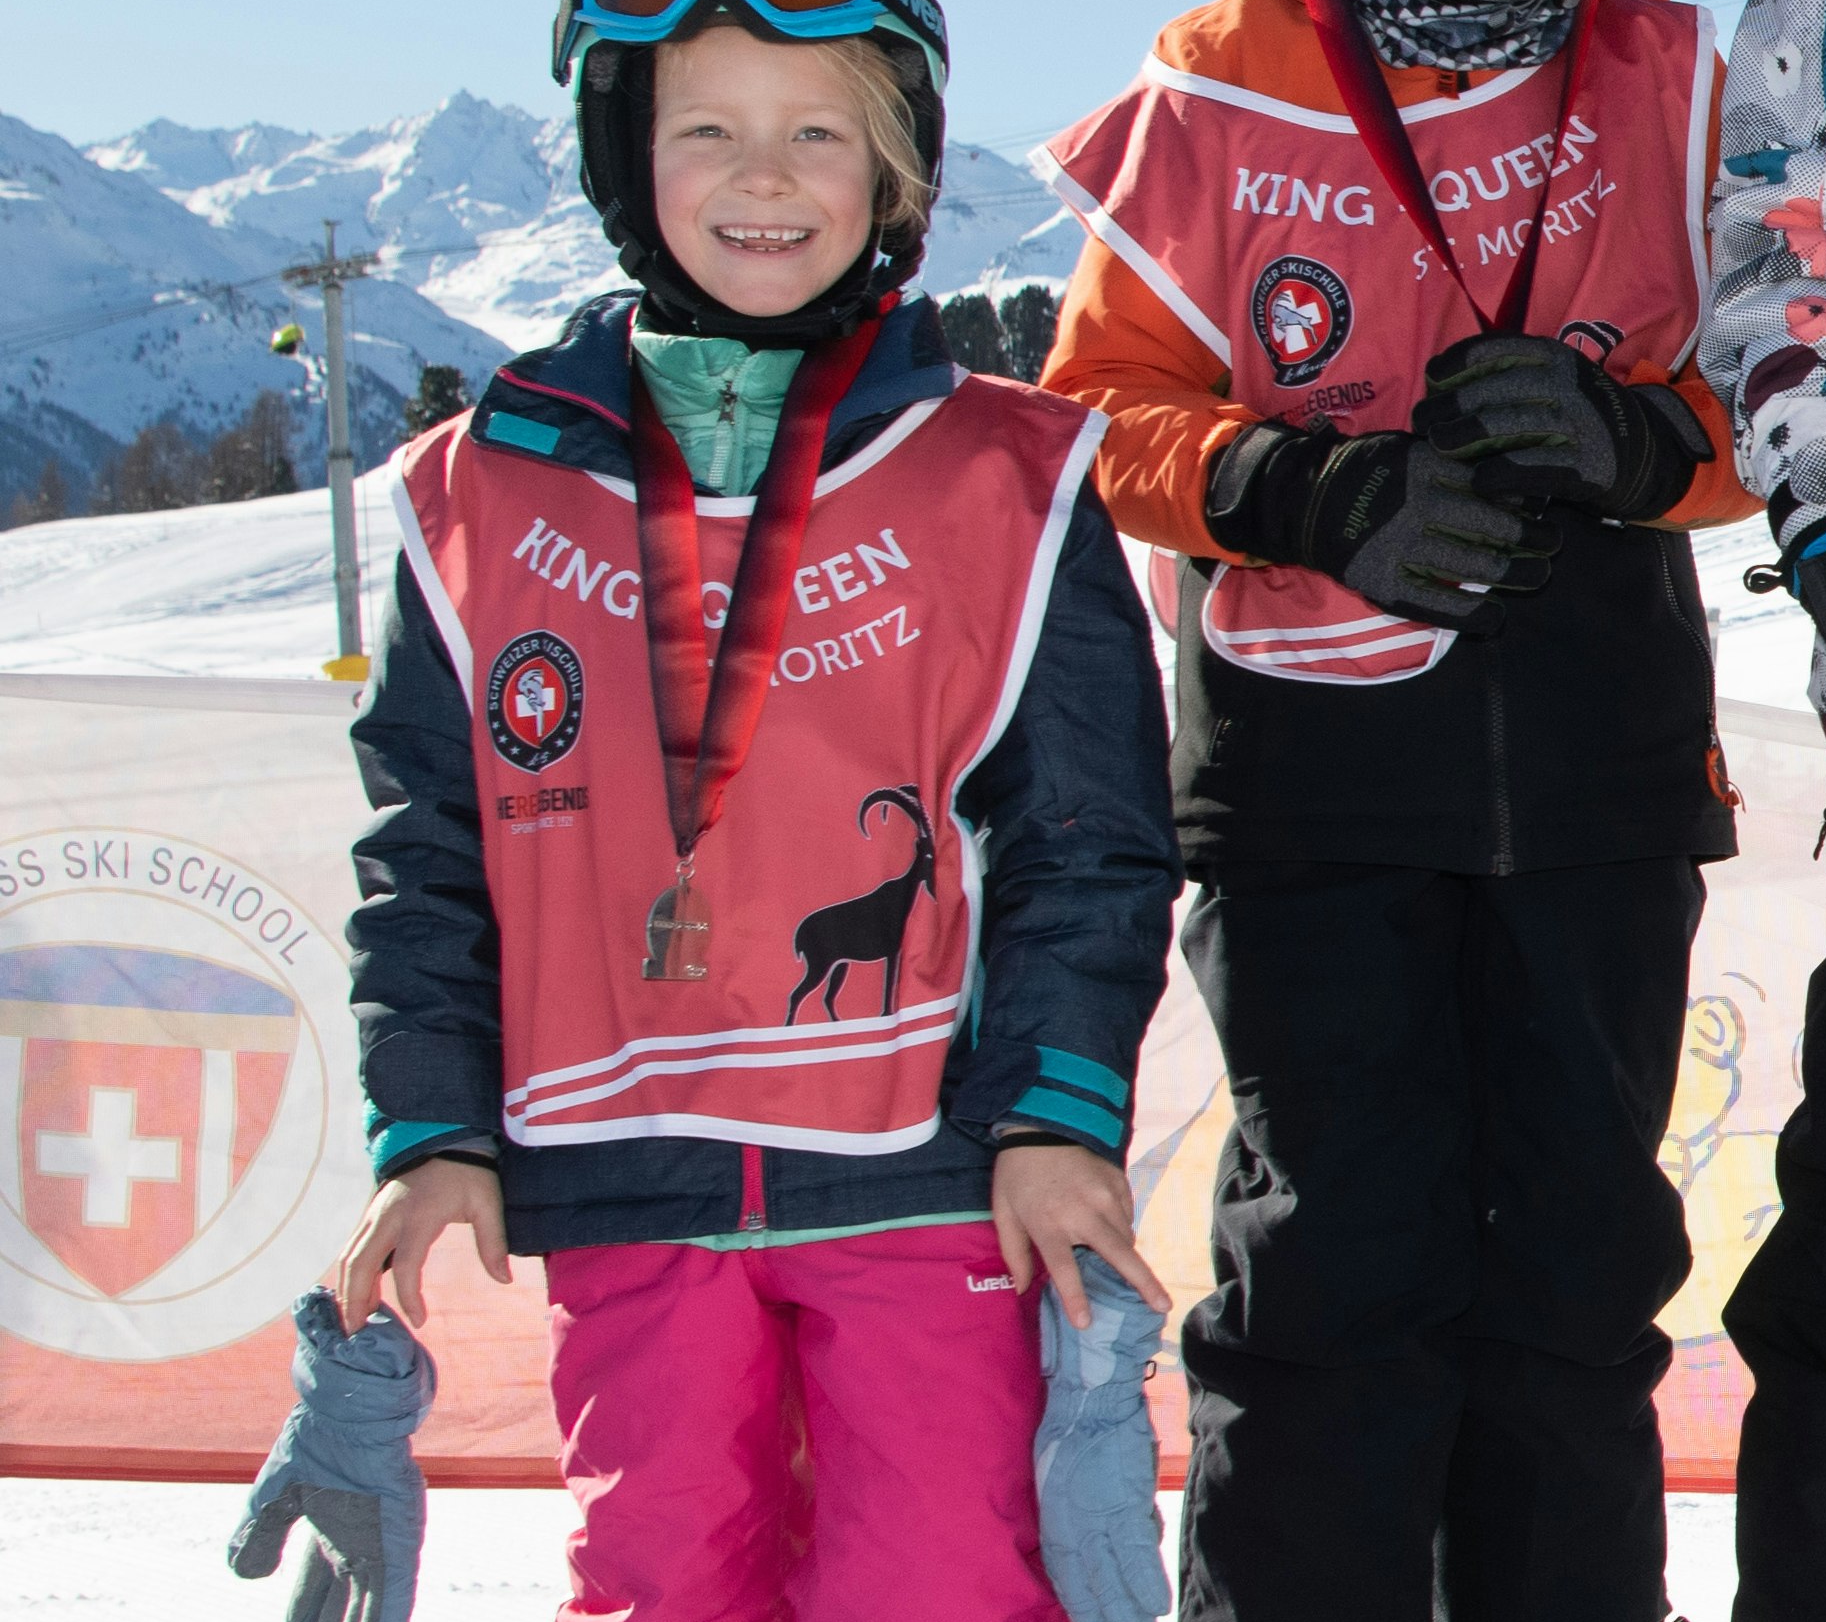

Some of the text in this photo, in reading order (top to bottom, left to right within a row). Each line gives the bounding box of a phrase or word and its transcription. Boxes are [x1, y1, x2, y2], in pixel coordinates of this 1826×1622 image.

[1232, 167, 1375, 227] KING
[1281, 262, 1347, 309] SKISCHULE
[512, 517, 911, 629] KING QEEN
[490, 639, 541, 711] SCHWEIZER
[770, 606, 920, 687] ORITZ
[62, 840, 130, 879] SKI
[149, 847, 309, 966] SCHOOL
